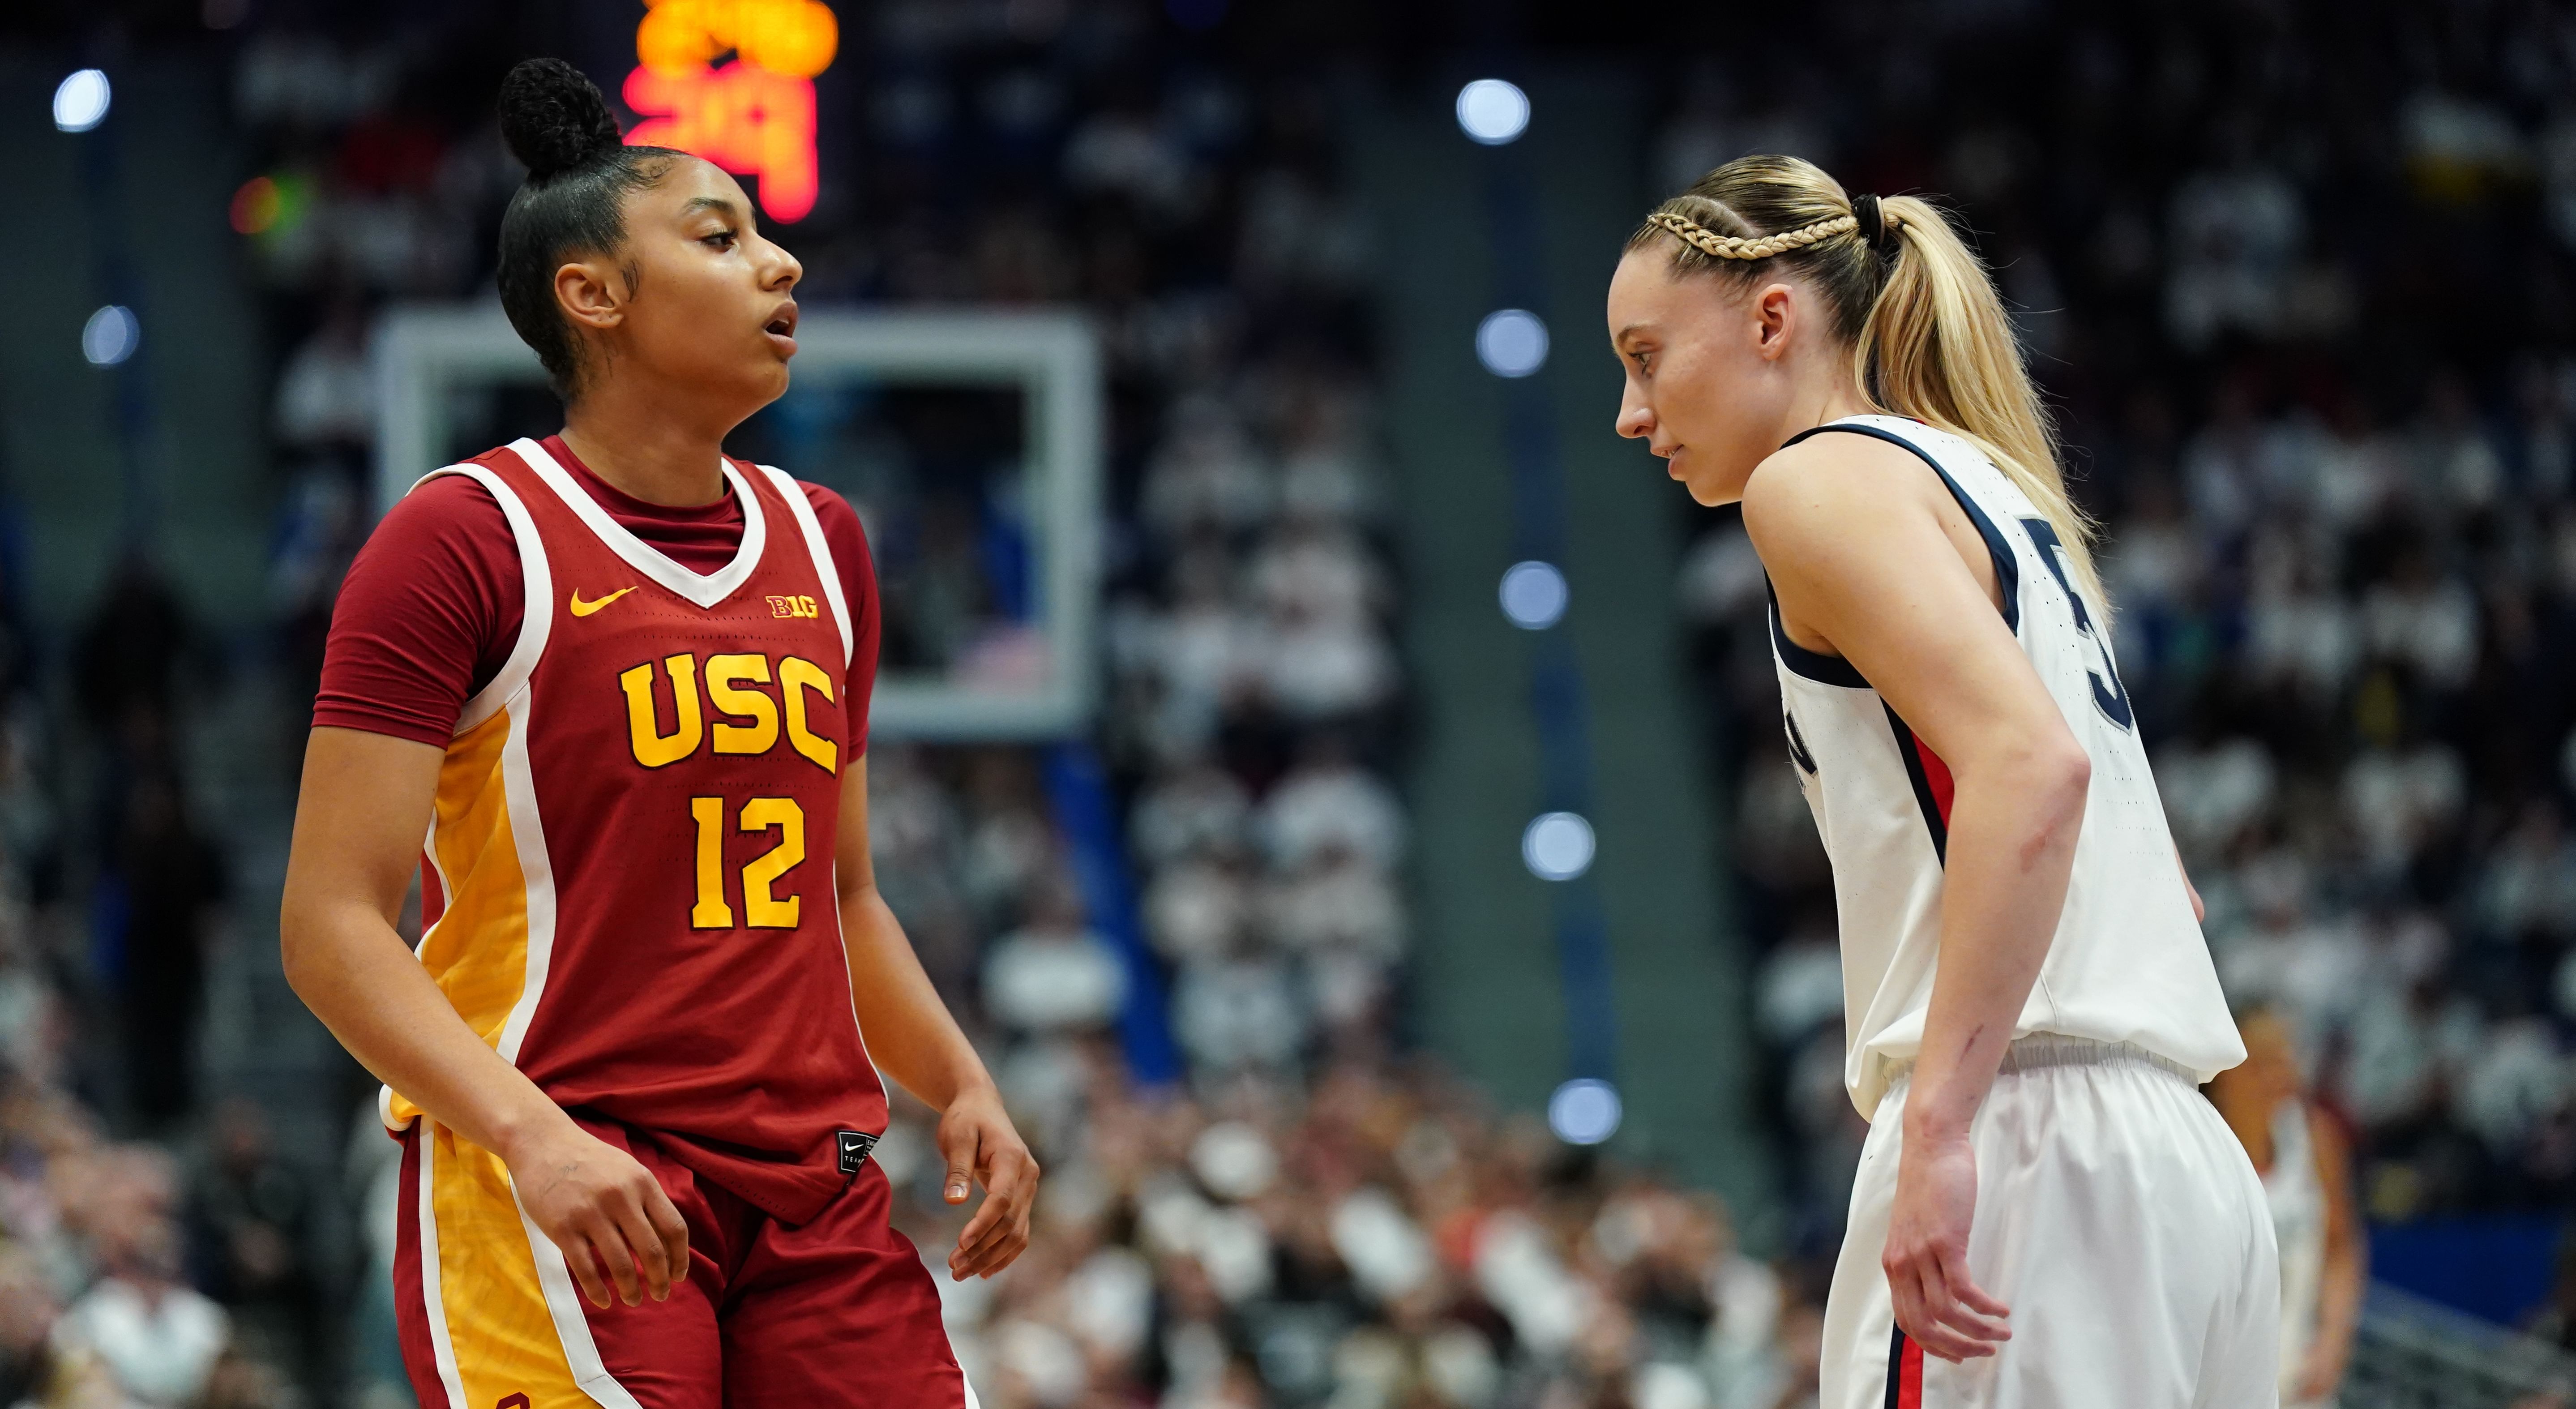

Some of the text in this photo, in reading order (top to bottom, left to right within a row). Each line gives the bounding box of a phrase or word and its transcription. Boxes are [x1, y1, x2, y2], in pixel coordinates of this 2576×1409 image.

[2013, 514, 2135, 736] 5
[618, 652, 839, 778] USC
[690, 795, 805, 930] 12
